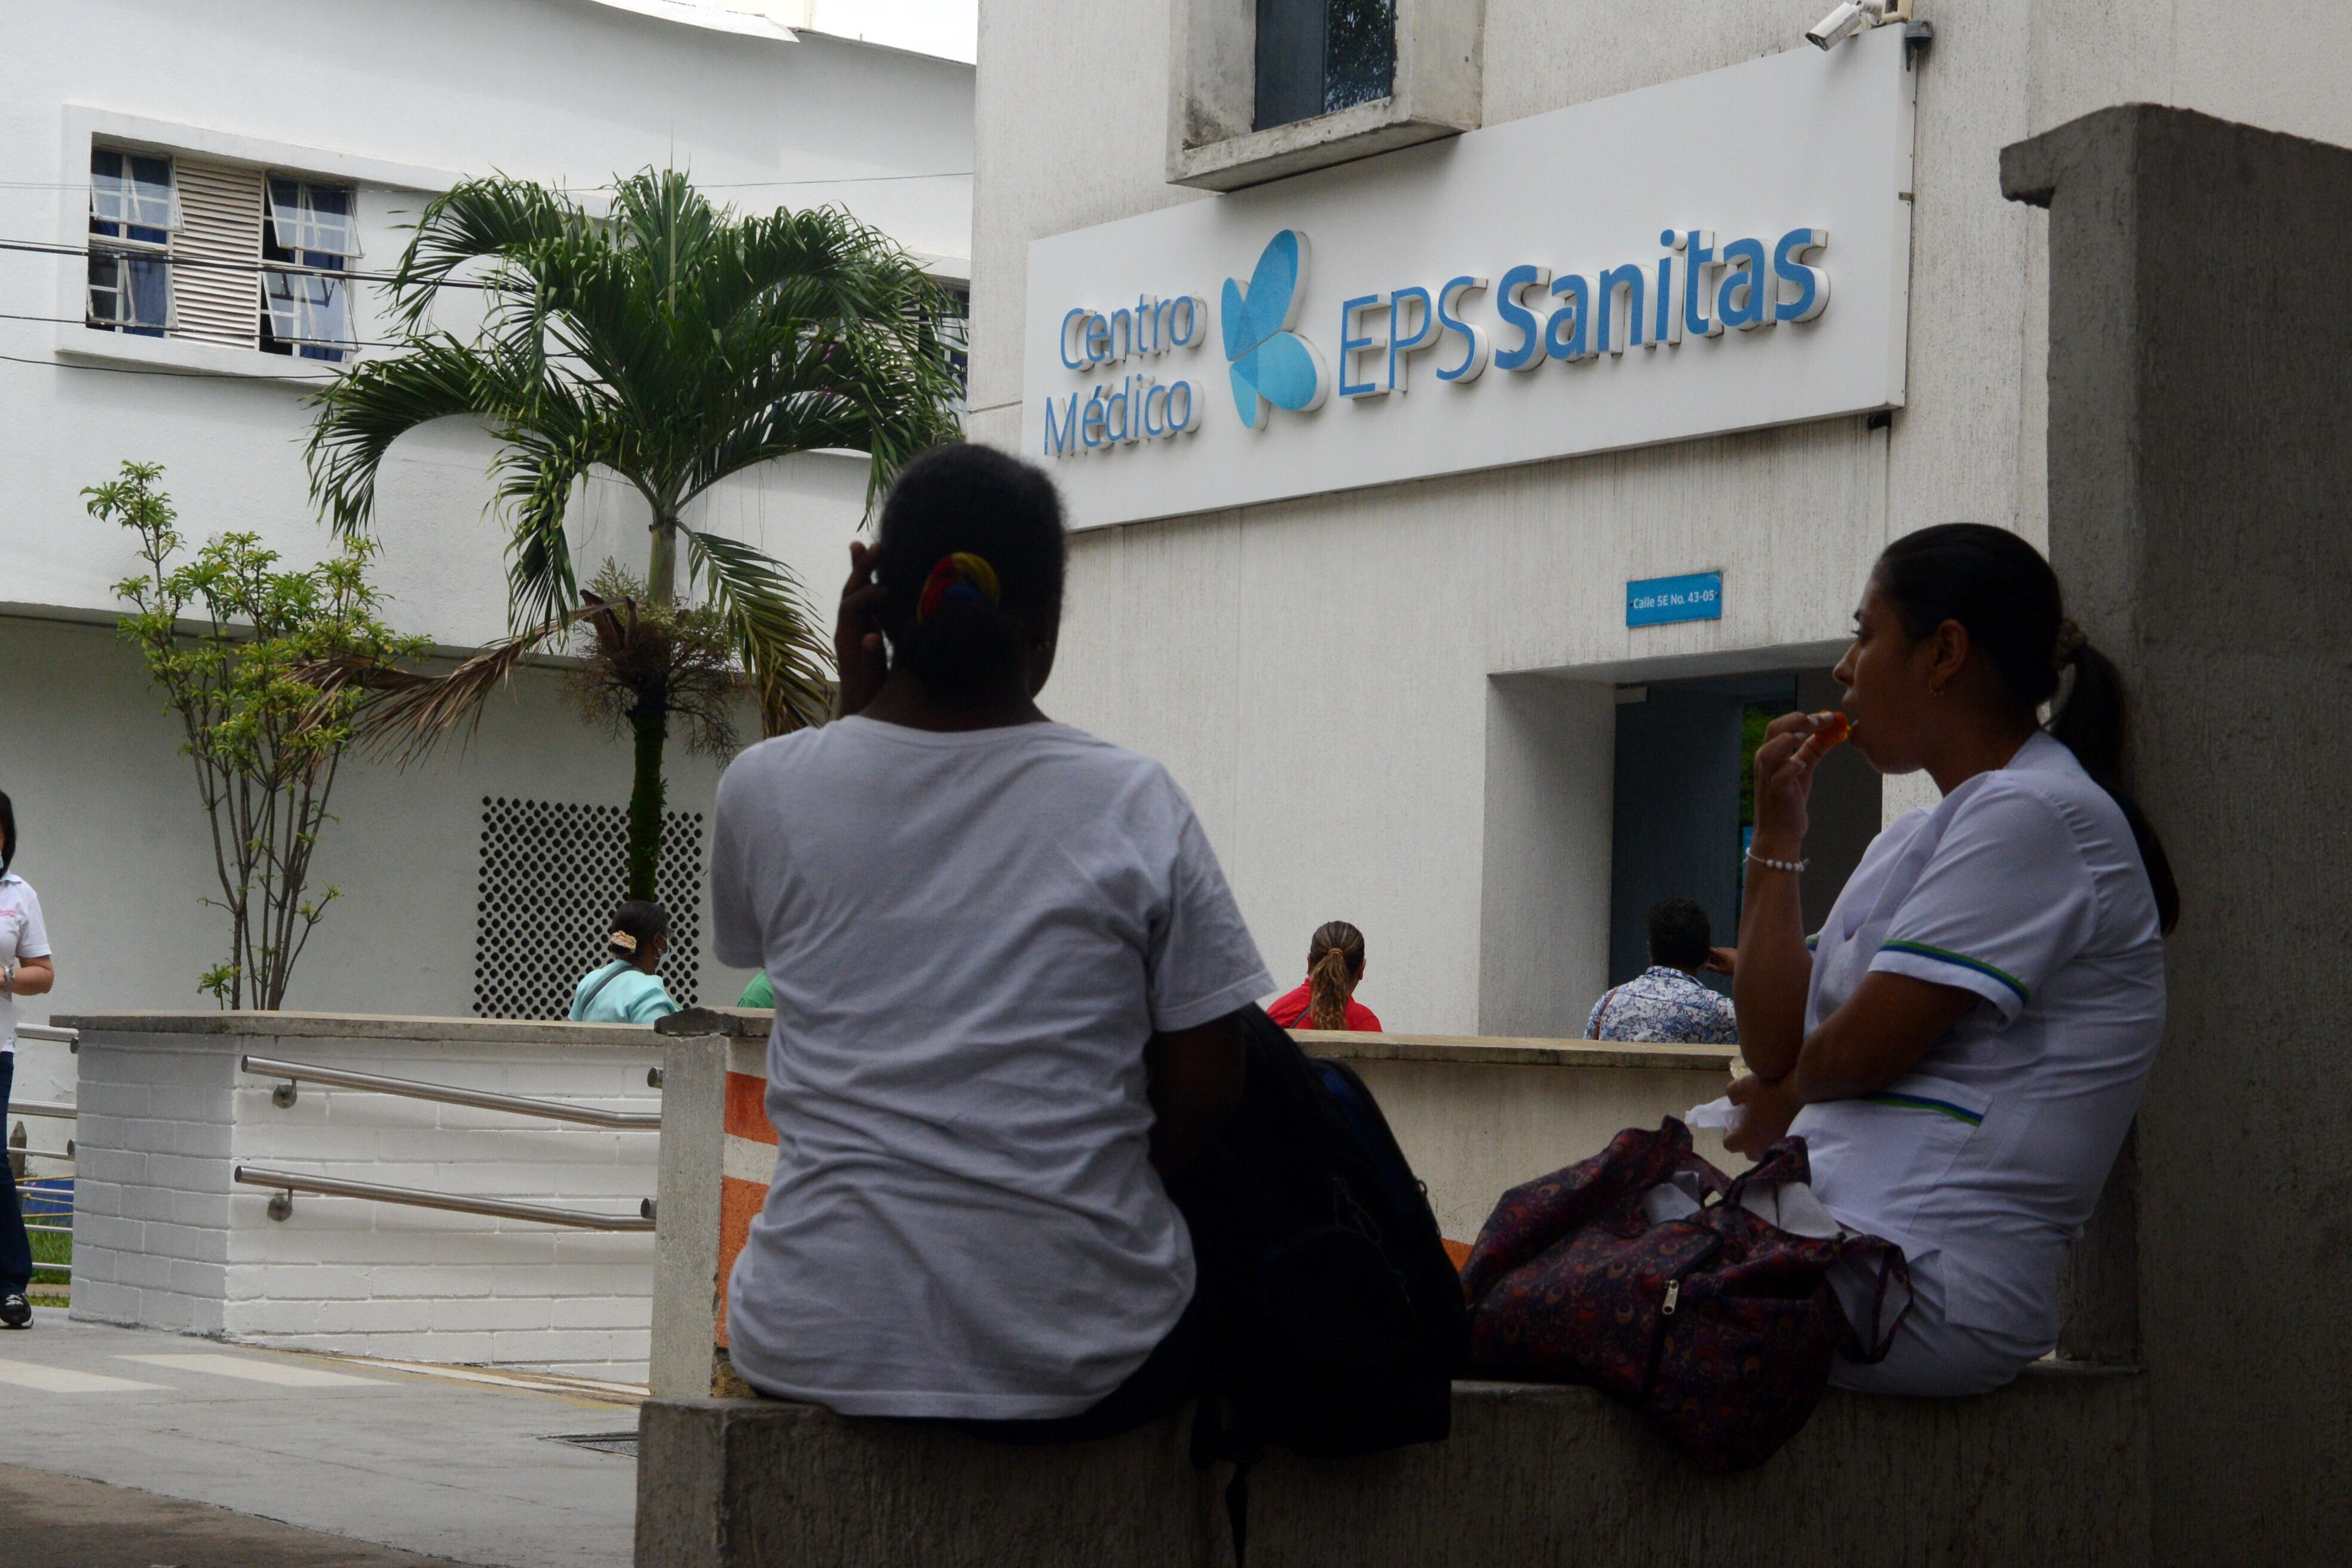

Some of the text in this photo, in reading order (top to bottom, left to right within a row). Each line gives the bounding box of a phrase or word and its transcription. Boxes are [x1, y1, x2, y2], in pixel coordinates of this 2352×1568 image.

[1061, 293, 1196, 369] Centro
[1339, 228, 1815, 397] EPS Sanitas
[1044, 373, 1192, 456] Médico
[1633, 590, 1714, 609] Calle 5E No. 43-05
